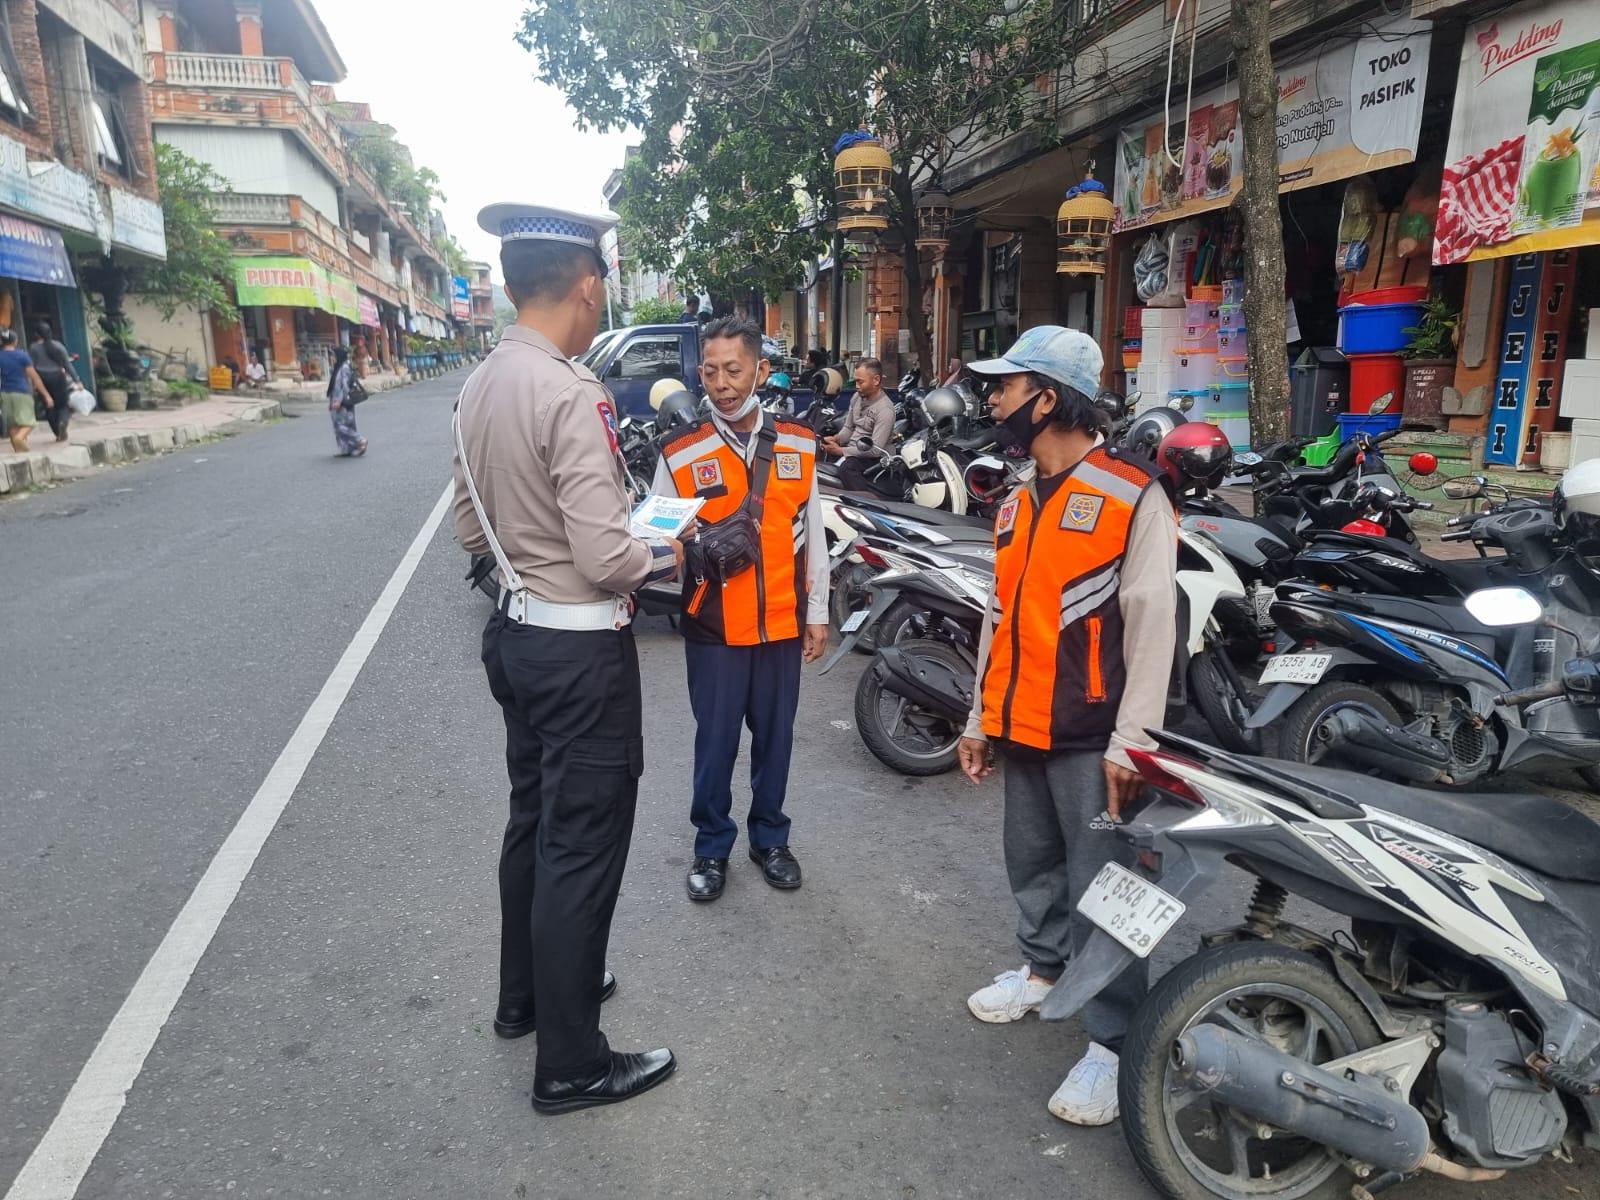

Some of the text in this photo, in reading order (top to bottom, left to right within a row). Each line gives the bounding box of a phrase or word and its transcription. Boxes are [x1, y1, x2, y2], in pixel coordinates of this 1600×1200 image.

[1480, 18, 1563, 75] Pudding
[1369, 47, 1411, 75] TOKO
[1360, 77, 1416, 110] PASIFIK
[1550, 70, 1595, 97] Pudding
[1289, 101, 1324, 121] Pudding
[1291, 119, 1335, 143] Nutrijell
[245, 267, 305, 288] PUTRA
[1310, 657, 1327, 668] AB
[1089, 821, 1117, 831] adid
[1096, 865, 1177, 925] DK 6548 TF
